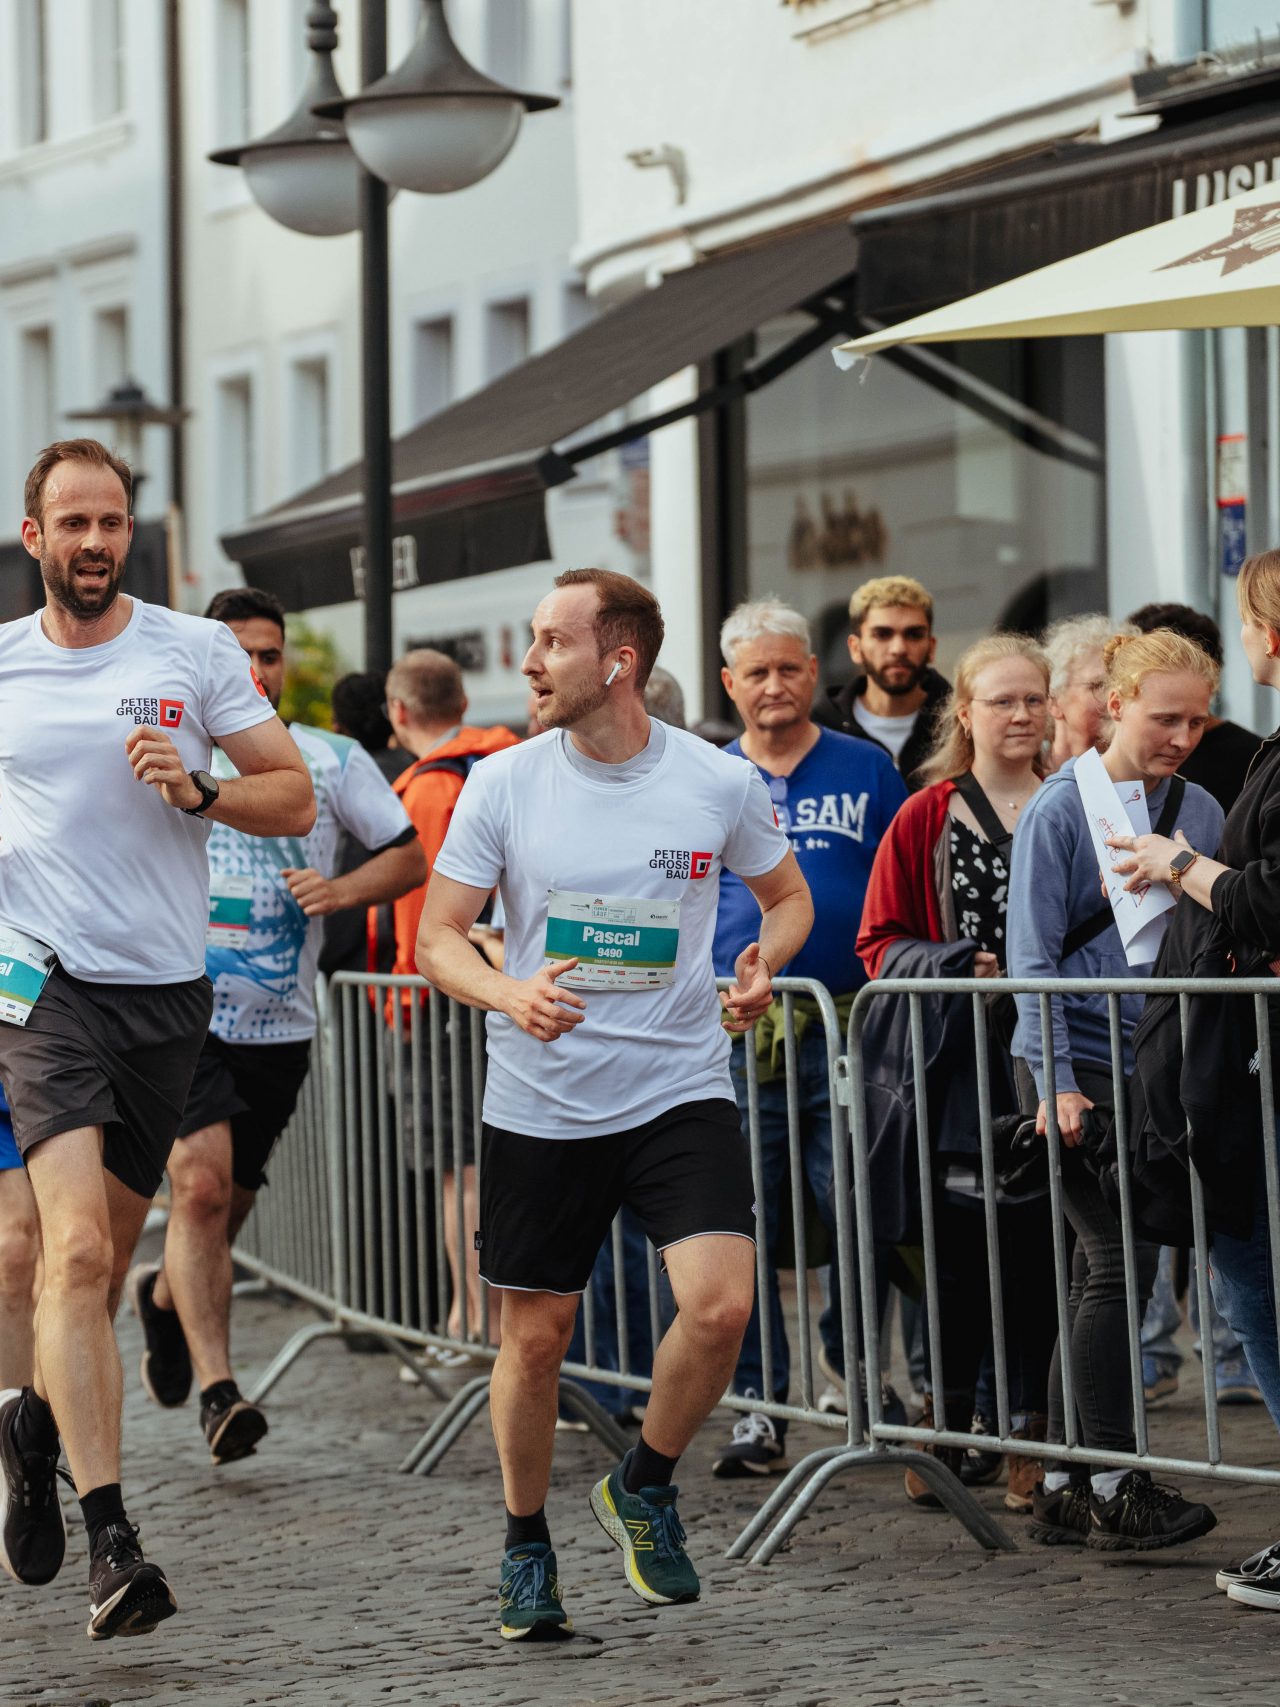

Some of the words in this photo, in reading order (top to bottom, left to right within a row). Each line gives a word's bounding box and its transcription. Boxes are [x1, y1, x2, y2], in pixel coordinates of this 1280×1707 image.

[121, 698, 158, 707] PETER
[116, 707, 158, 716] GROSS
[134, 716, 158, 726] BAU
[796, 792, 869, 842] SAM
[654, 849, 690, 860] PETER
[649, 859, 690, 870] GROSS
[666, 870, 689, 879] BAU
[582, 925, 641, 946] Pascal
[597, 947, 623, 958] 9490
